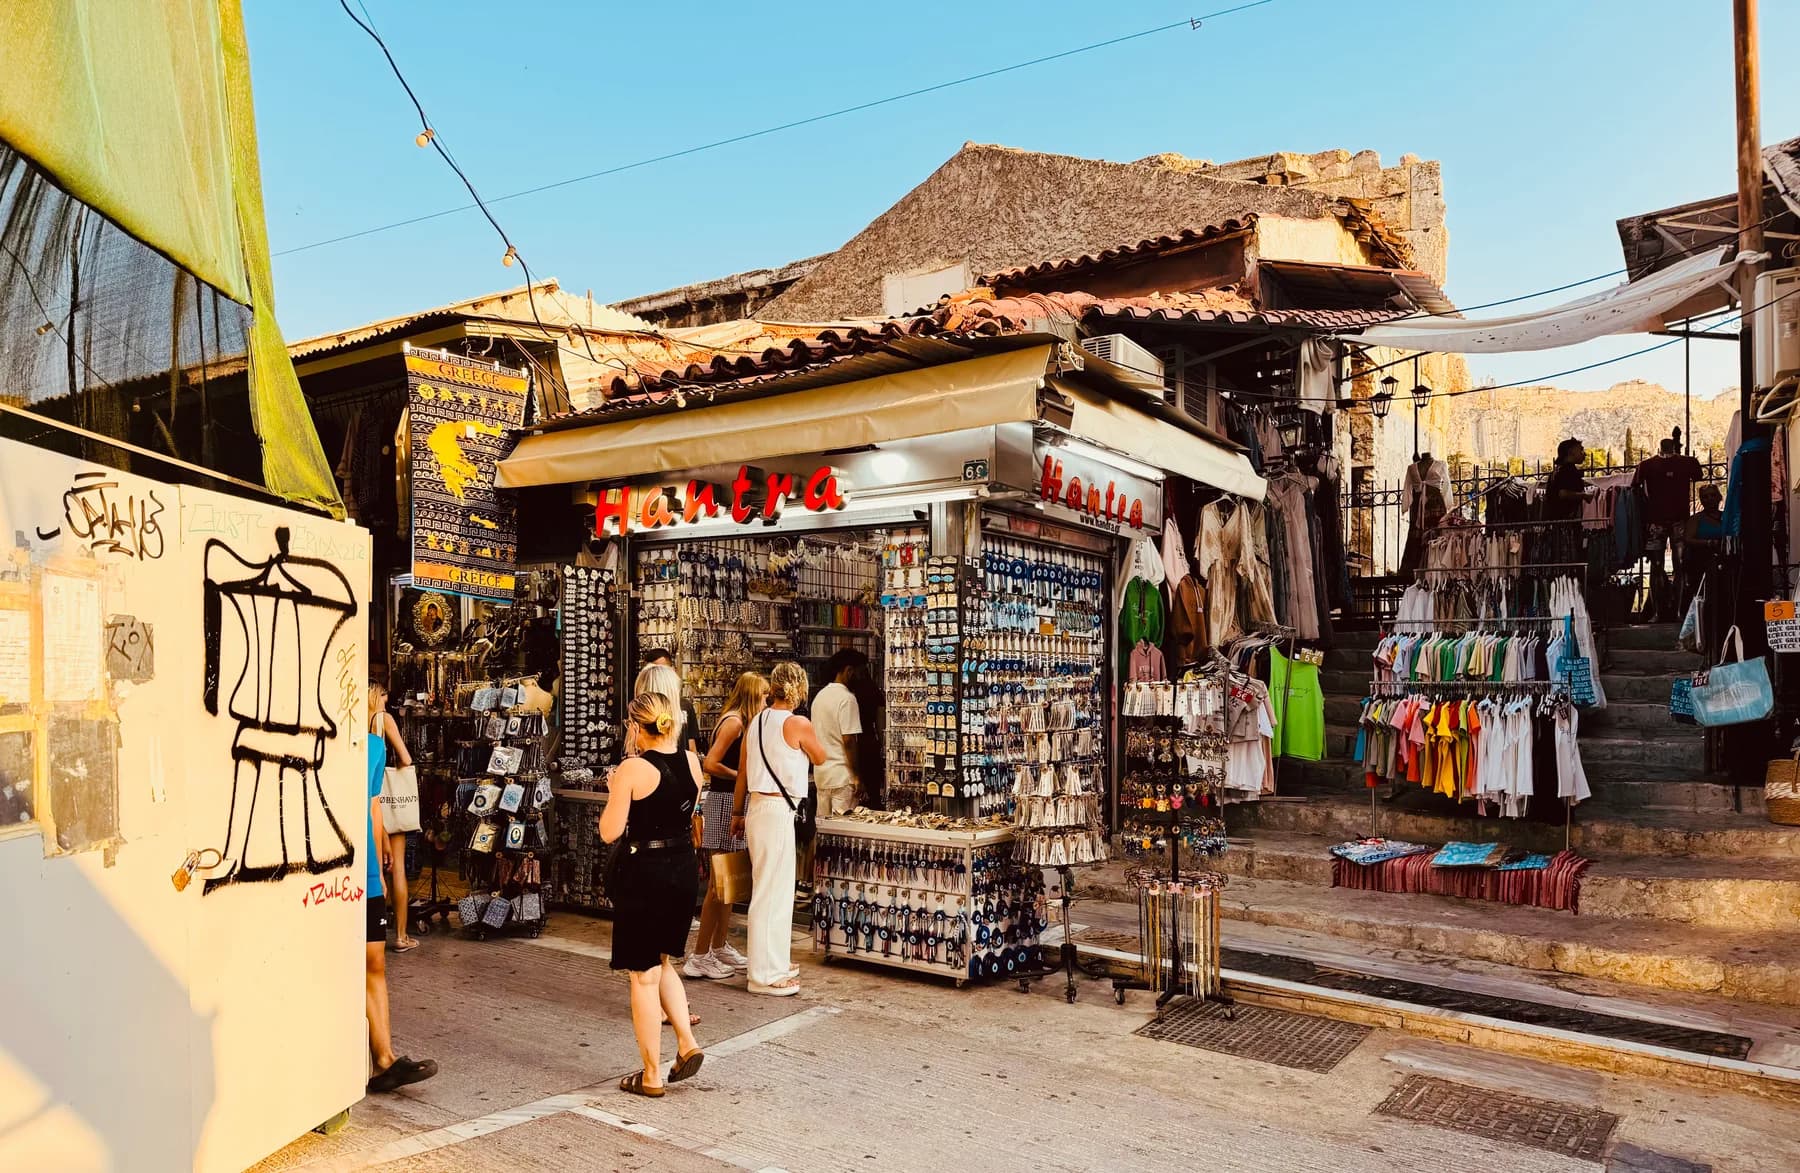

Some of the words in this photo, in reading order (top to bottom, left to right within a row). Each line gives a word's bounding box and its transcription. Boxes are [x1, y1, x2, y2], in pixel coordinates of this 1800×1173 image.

[438, 364, 500, 386] GREECE
[594, 465, 844, 537] Hantra
[1041, 453, 1143, 529] Hantra
[448, 569, 501, 587] GREECE
[379, 795, 417, 804] ØBENHAVN
